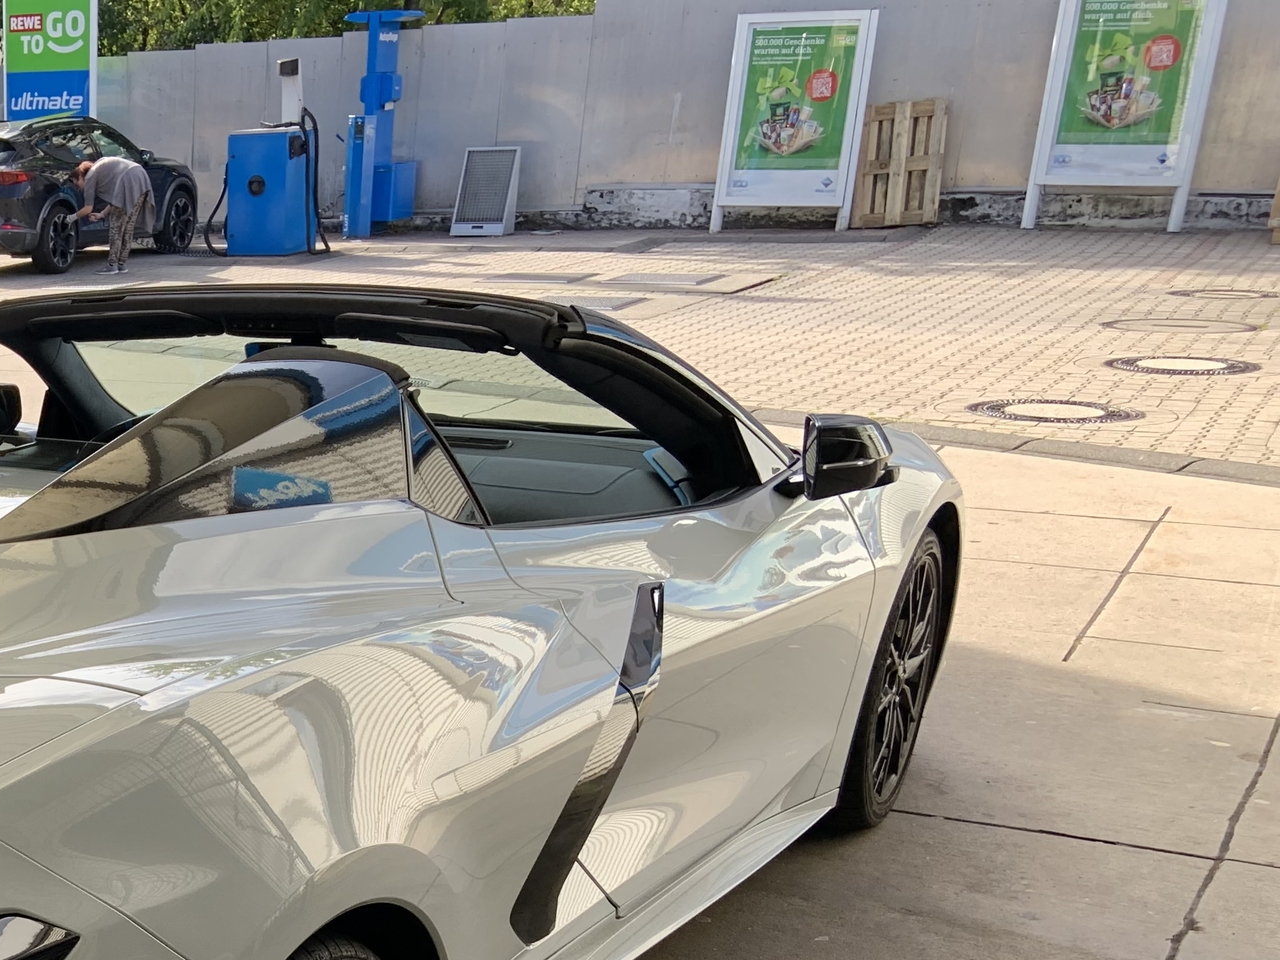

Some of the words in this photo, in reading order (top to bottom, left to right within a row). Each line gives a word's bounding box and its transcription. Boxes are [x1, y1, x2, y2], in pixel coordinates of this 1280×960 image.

[10, 16, 41, 30] REWE
[46, 10, 86, 38] GO
[20, 34, 44, 54] TO
[11, 91, 84, 110] ultimate
